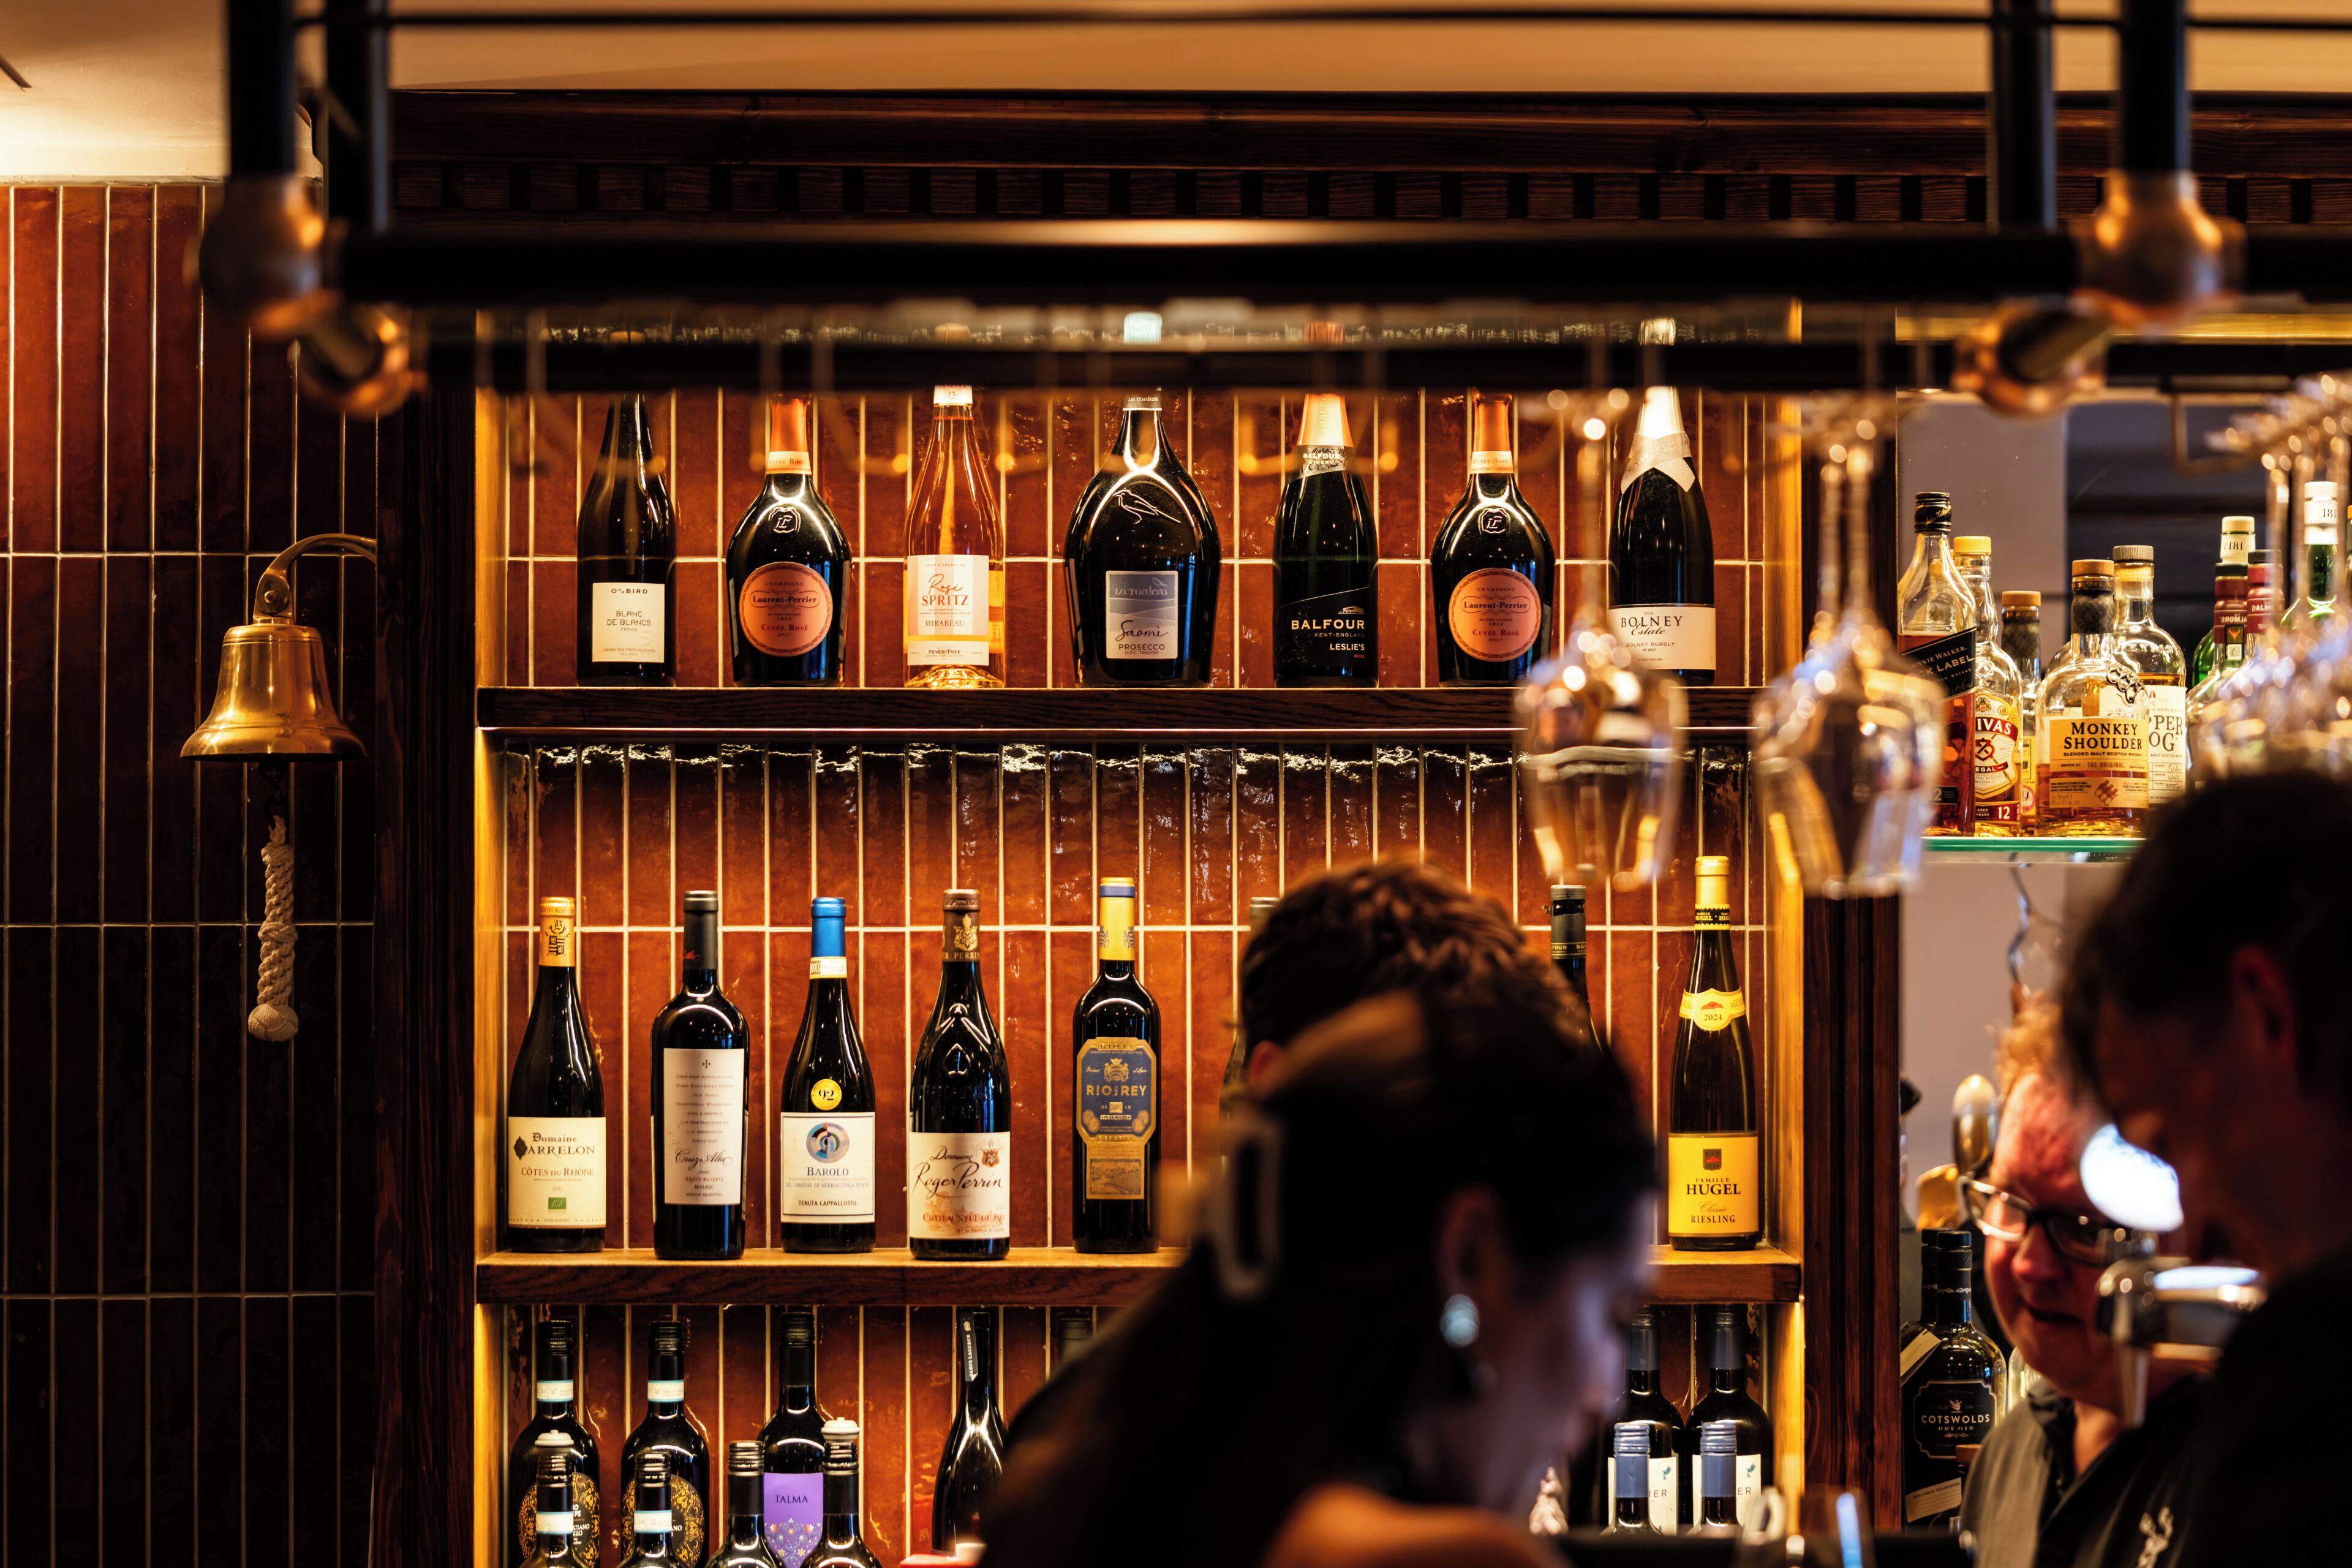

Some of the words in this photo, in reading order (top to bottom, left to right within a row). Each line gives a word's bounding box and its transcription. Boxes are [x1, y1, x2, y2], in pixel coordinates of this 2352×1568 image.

[2323, 508, 2337, 518] 181
[928, 573, 963, 595] Rosé
[922, 595, 969, 606] SPRITZ
[2252, 603, 2283, 612] DALME
[1291, 619, 1365, 630] BALFOUR
[1621, 616, 1683, 628] BOLNEY
[1630, 621, 1666, 636] Estate
[1936, 646, 1966, 660] WALKER
[1936, 655, 1973, 672] LABEL
[1977, 717, 2012, 736] IVAS
[2071, 722, 2138, 736] MONKEY
[2064, 736, 2143, 750] SHOULDER
[2149, 731, 2175, 752] OG
[1997, 805, 2011, 820] 12
[818, 1088, 834, 1101] 92
[1087, 1084, 1112, 1096] RIO
[1121, 1084, 1147, 1096] REY
[532, 1133, 578, 1142] Domaine
[675, 1147, 703, 1171] Cruz
[929, 1145, 973, 1162] Domaine
[521, 1166, 549, 1176] CÔTES
[564, 1167, 594, 1176] RHÔNE
[807, 1166, 850, 1177] BAROLO
[911, 1162, 956, 1200] Roger
[952, 1162, 1003, 1193] Perrin
[1686, 1183, 1741, 1195] HUGEL
[1698, 1200, 1727, 1213] Classic
[1691, 1215, 1735, 1223] RIESLING
[1921, 1414, 1990, 1424] COTSWOLDS
[774, 1494, 809, 1504] TALMA
